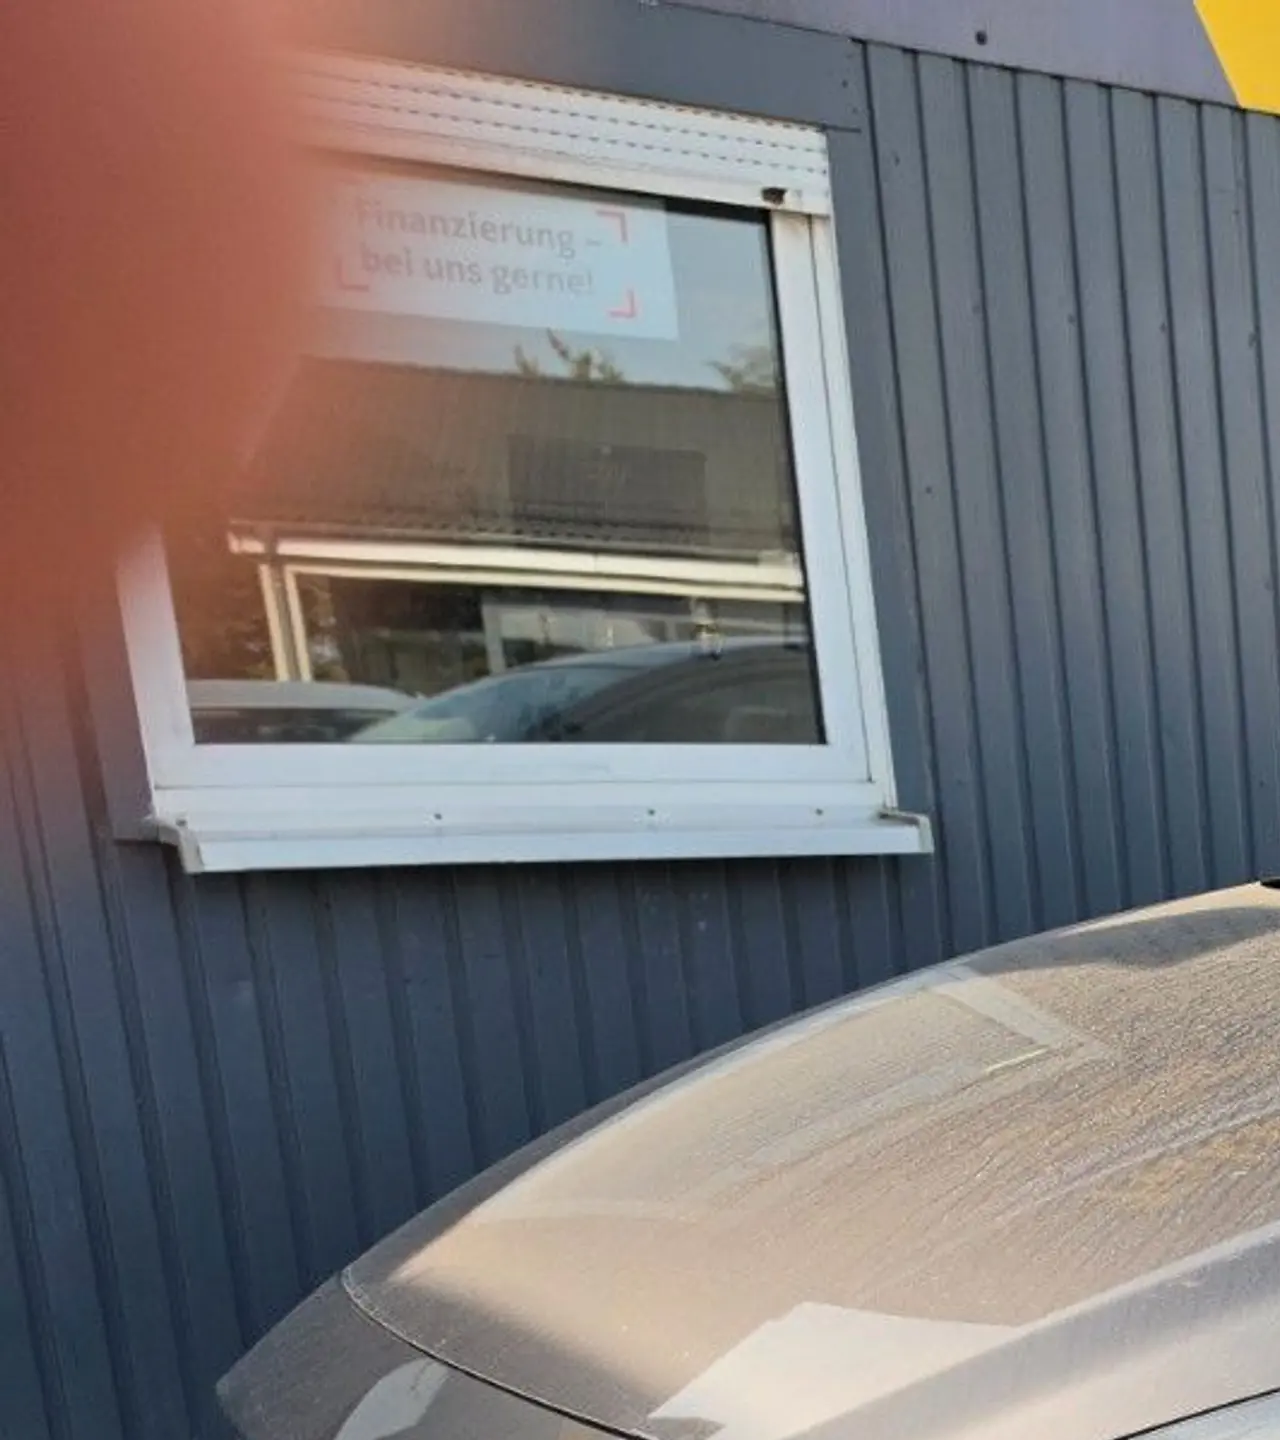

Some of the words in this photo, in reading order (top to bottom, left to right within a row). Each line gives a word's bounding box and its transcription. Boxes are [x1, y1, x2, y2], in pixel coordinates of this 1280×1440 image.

[357, 197, 577, 260] Finanzierung
[359, 244, 414, 279] bei
[424, 255, 482, 286] uns
